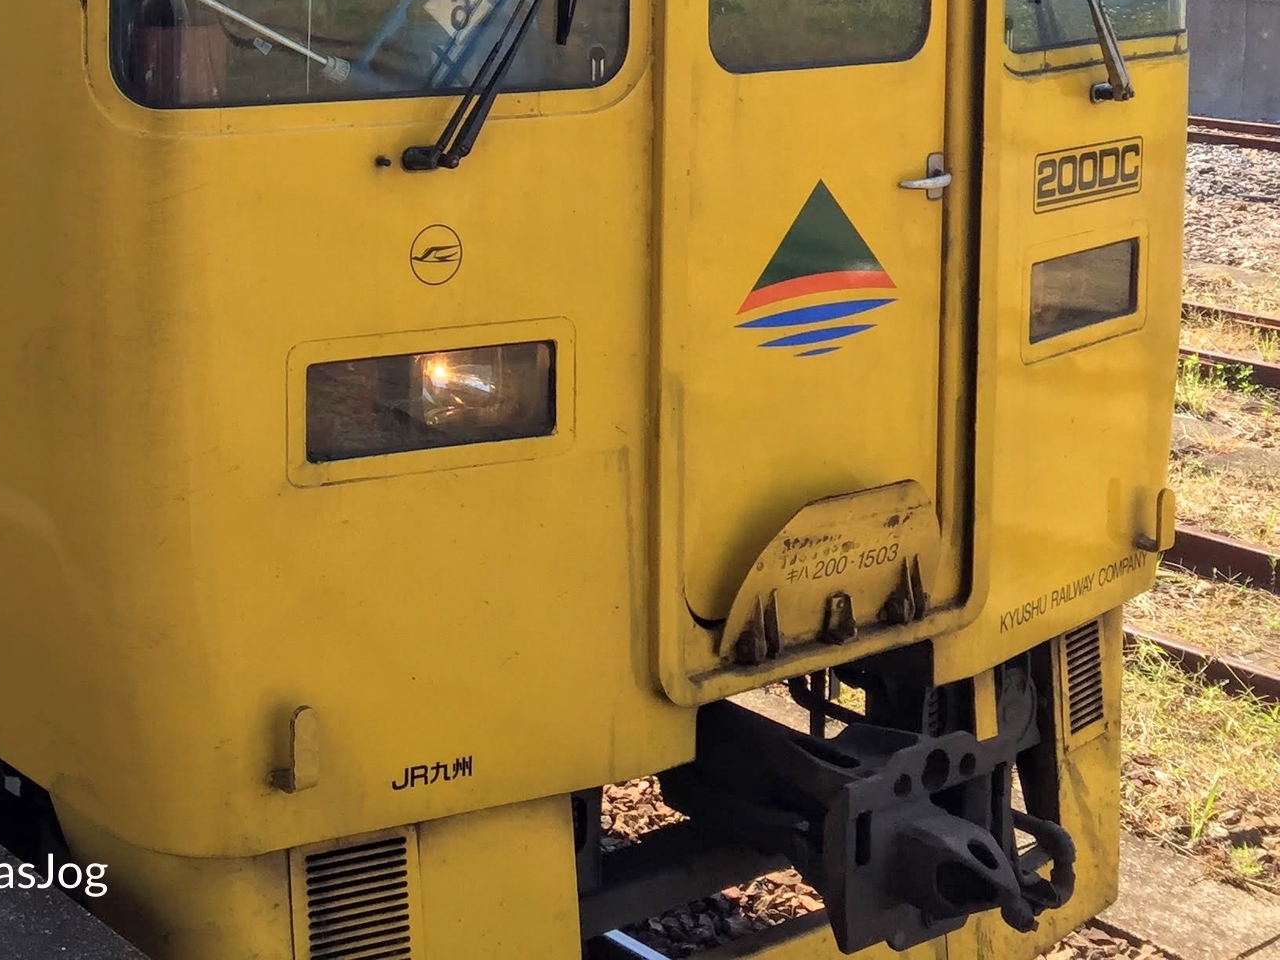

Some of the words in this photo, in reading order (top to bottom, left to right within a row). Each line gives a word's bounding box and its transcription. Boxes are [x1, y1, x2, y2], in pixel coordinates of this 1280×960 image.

[1037, 143, 1141, 199] 200DC
[1000, 594, 1048, 633] KYUSHU
[1050, 573, 1096, 610] RAILWAY
[1098, 549, 1149, 587] COMPANY
[392, 754, 474, 792] JR九州
